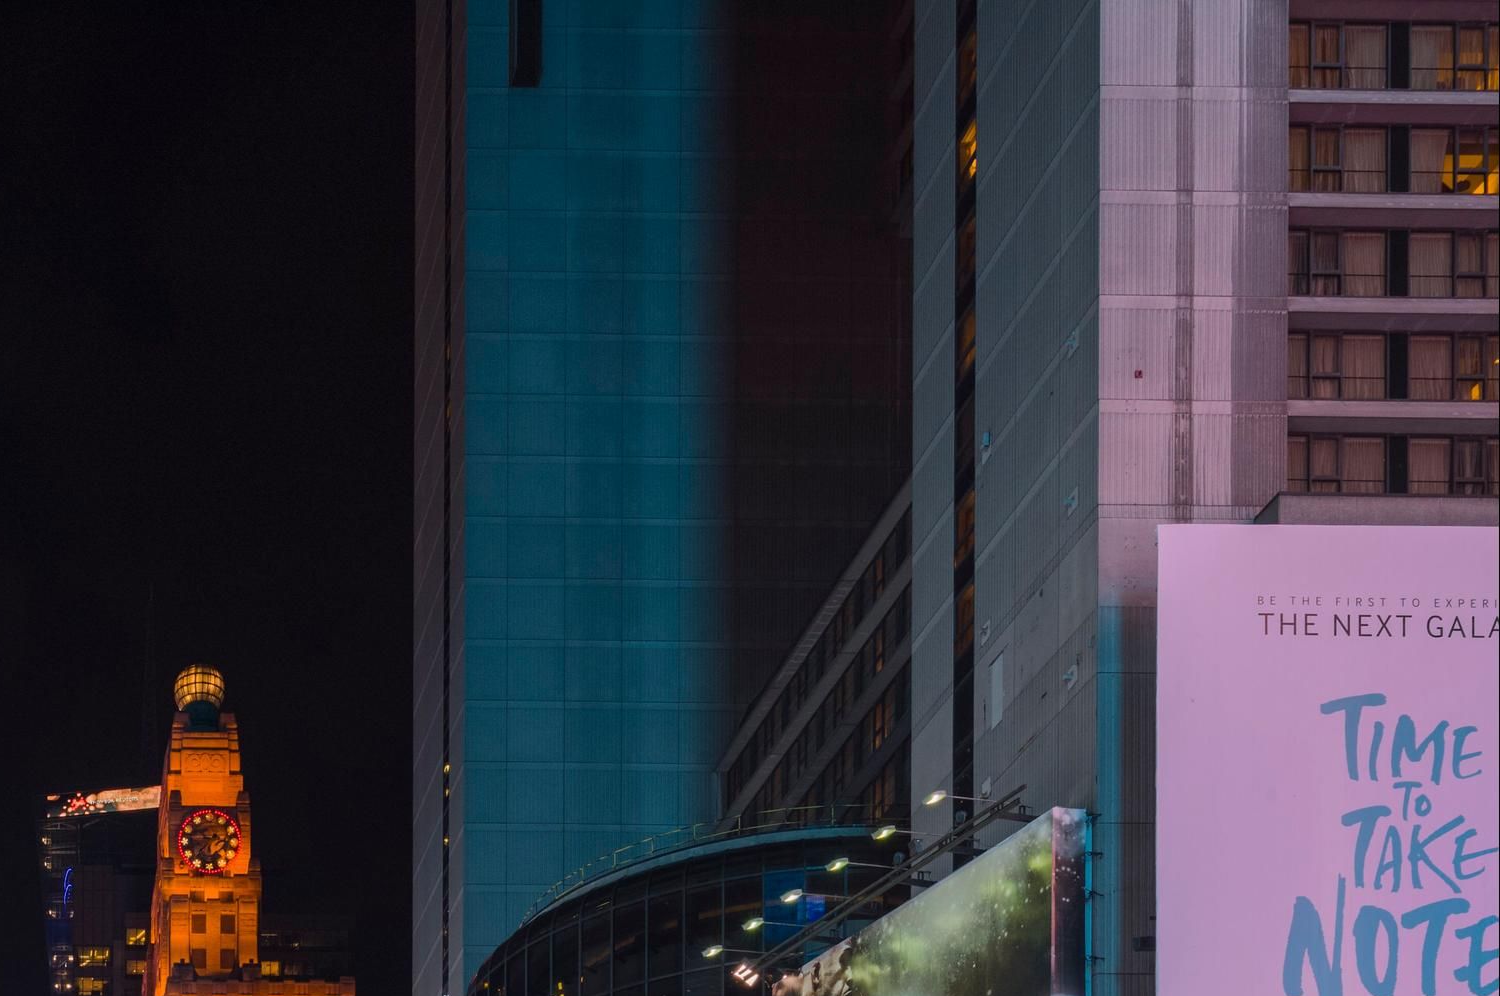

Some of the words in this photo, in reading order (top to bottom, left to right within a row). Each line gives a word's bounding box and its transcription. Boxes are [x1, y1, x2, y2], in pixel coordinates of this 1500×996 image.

[1257, 596, 1277, 606] BE
[1291, 596, 1323, 606] THE
[1336, 597, 1387, 607] FIRST
[1400, 598, 1421, 608] TO
[1258, 612, 1319, 636] THE
[1333, 614, 1412, 637] NEXT
[1320, 693, 1483, 785] TIME
[1392, 781, 1432, 821] TO
[1341, 805, 1499, 893] TAKE
